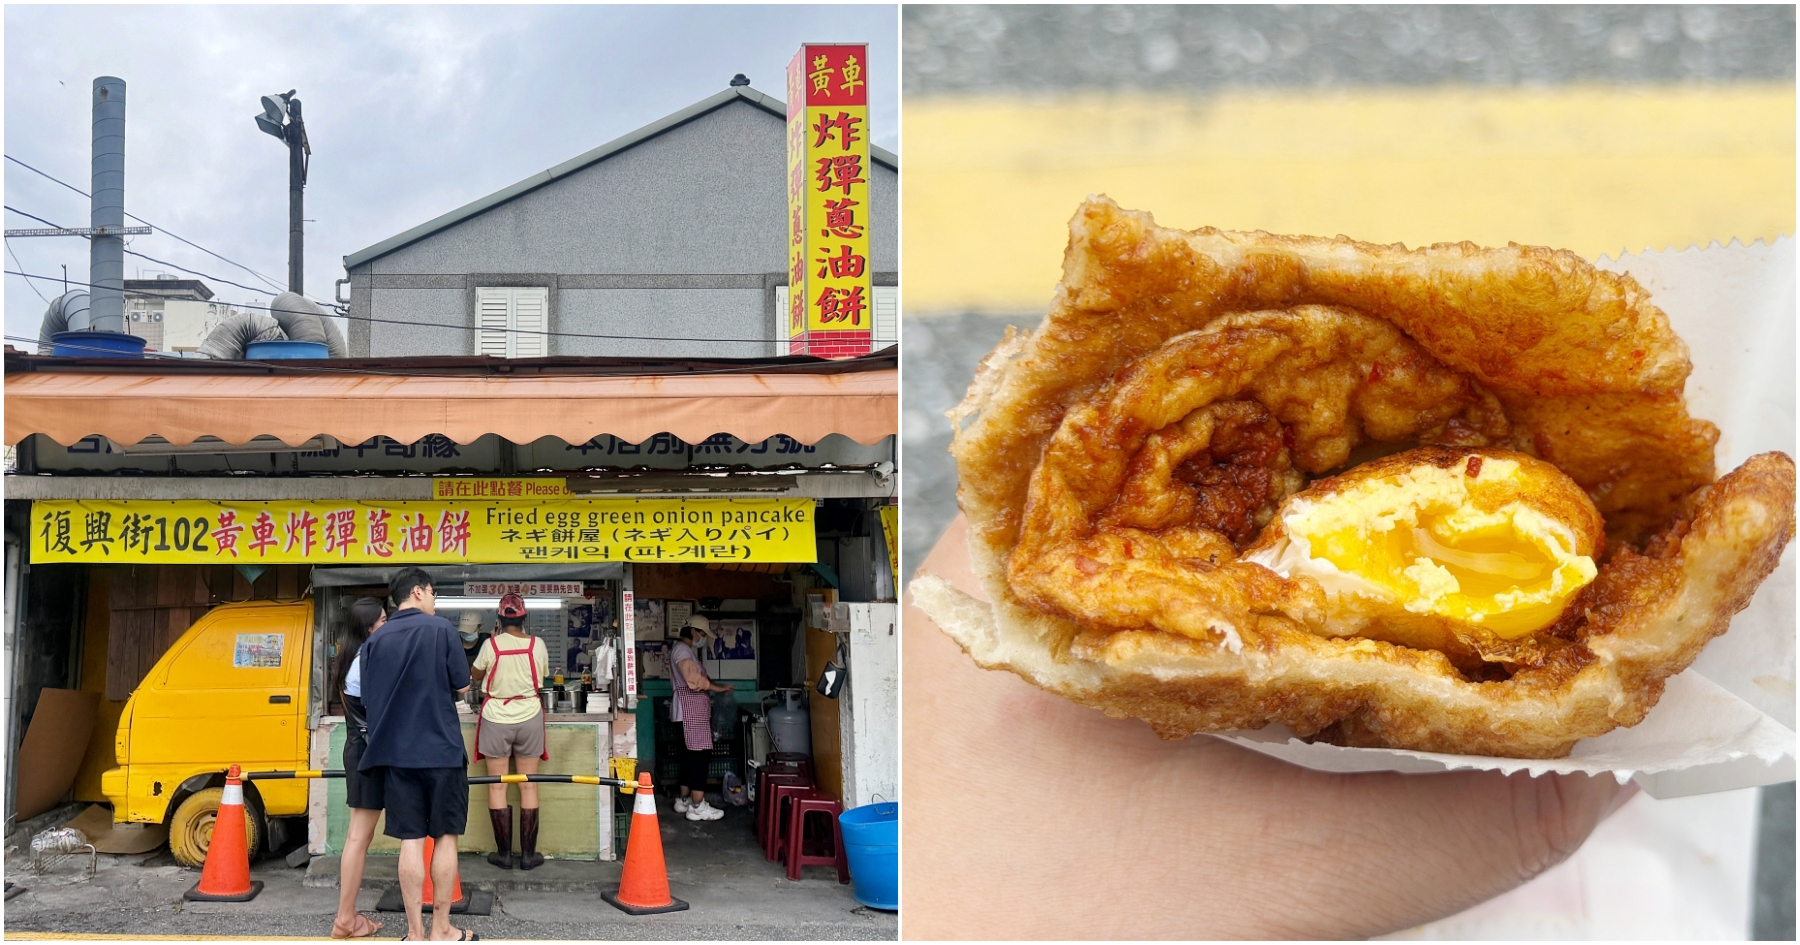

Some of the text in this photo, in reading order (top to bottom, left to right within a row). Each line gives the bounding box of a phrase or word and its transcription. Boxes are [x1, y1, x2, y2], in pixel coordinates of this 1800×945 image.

[808, 54, 865, 98] 黃車
[812, 111, 866, 326] 炸彈蔥油餅
[438, 480, 523, 497] 請在此點餐
[526, 482, 560, 495] Please
[486, 505, 806, 528] Fried egg green onion pancake
